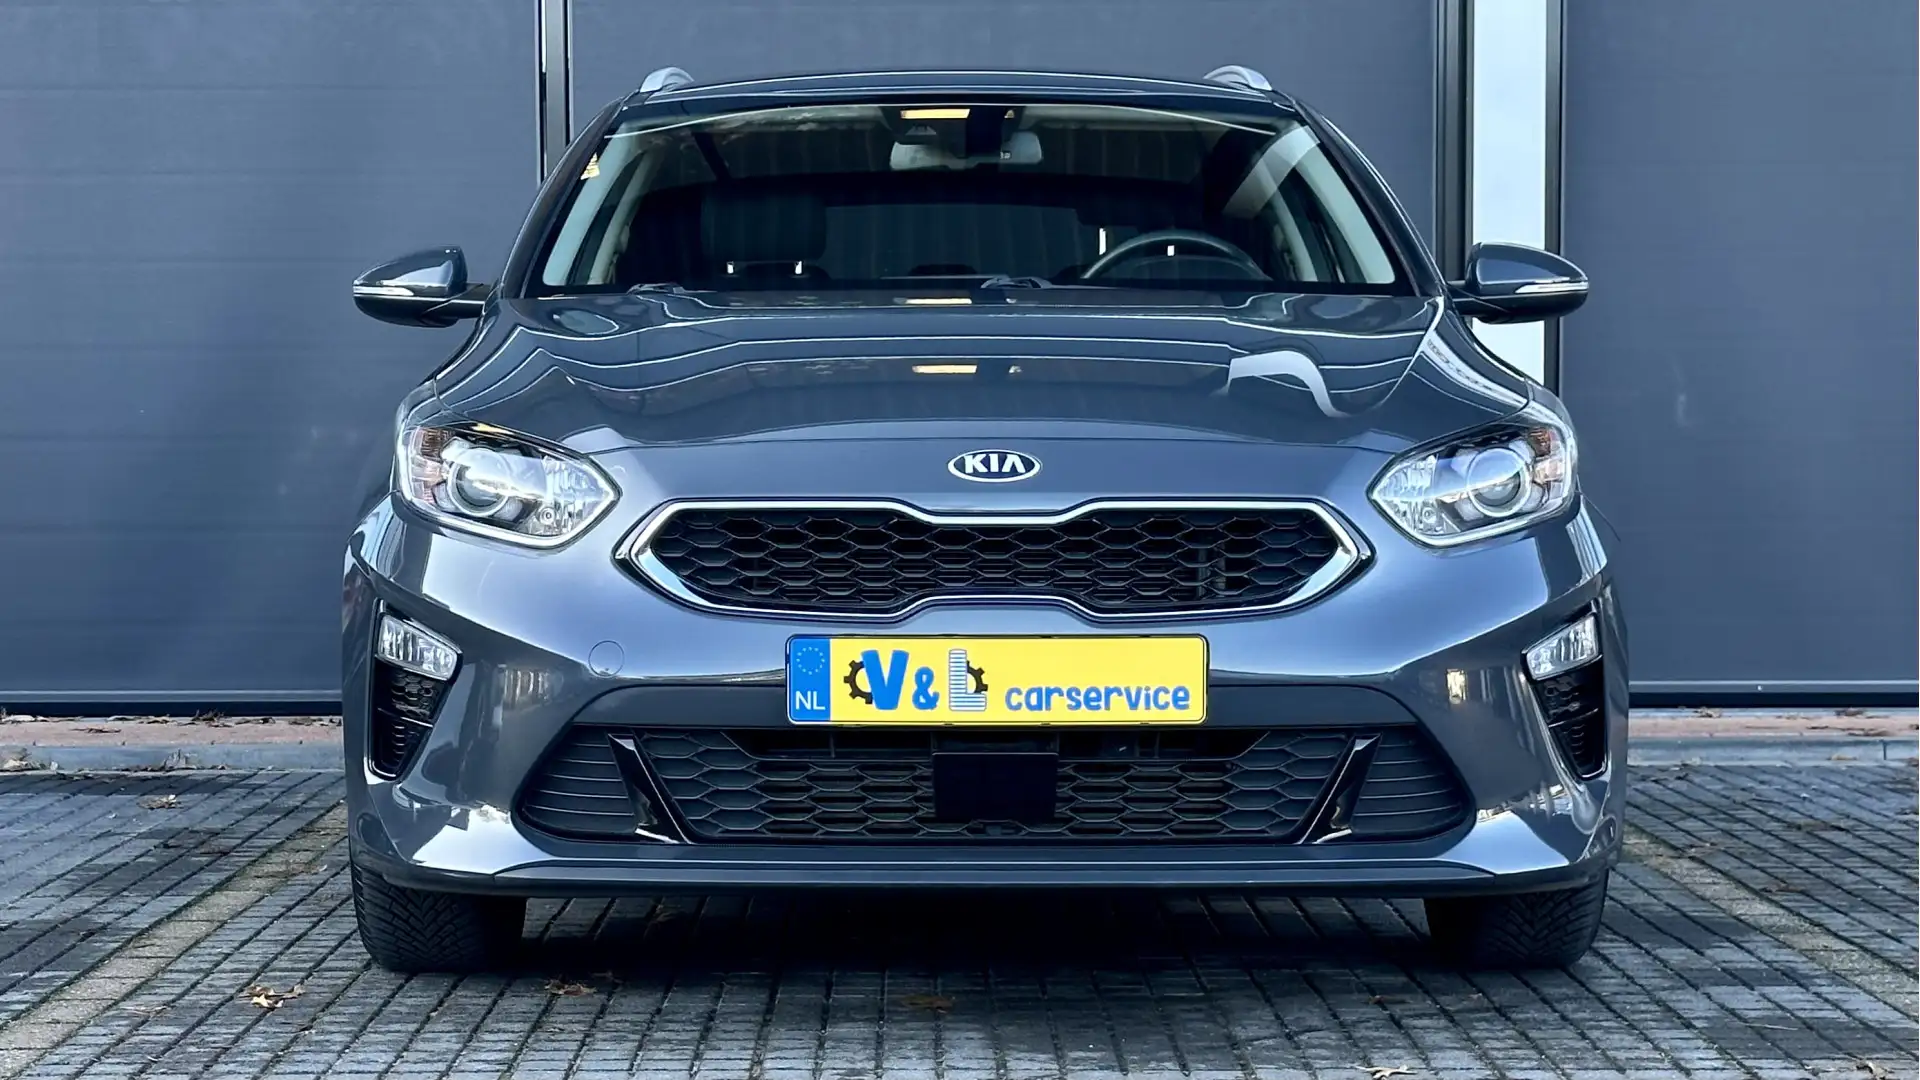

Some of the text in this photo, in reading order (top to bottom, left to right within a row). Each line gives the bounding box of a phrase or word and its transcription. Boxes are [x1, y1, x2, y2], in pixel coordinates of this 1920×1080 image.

[964, 453, 1027, 474] KIA
[795, 690, 826, 711] NL
[1005, 685, 1190, 712] carservice
